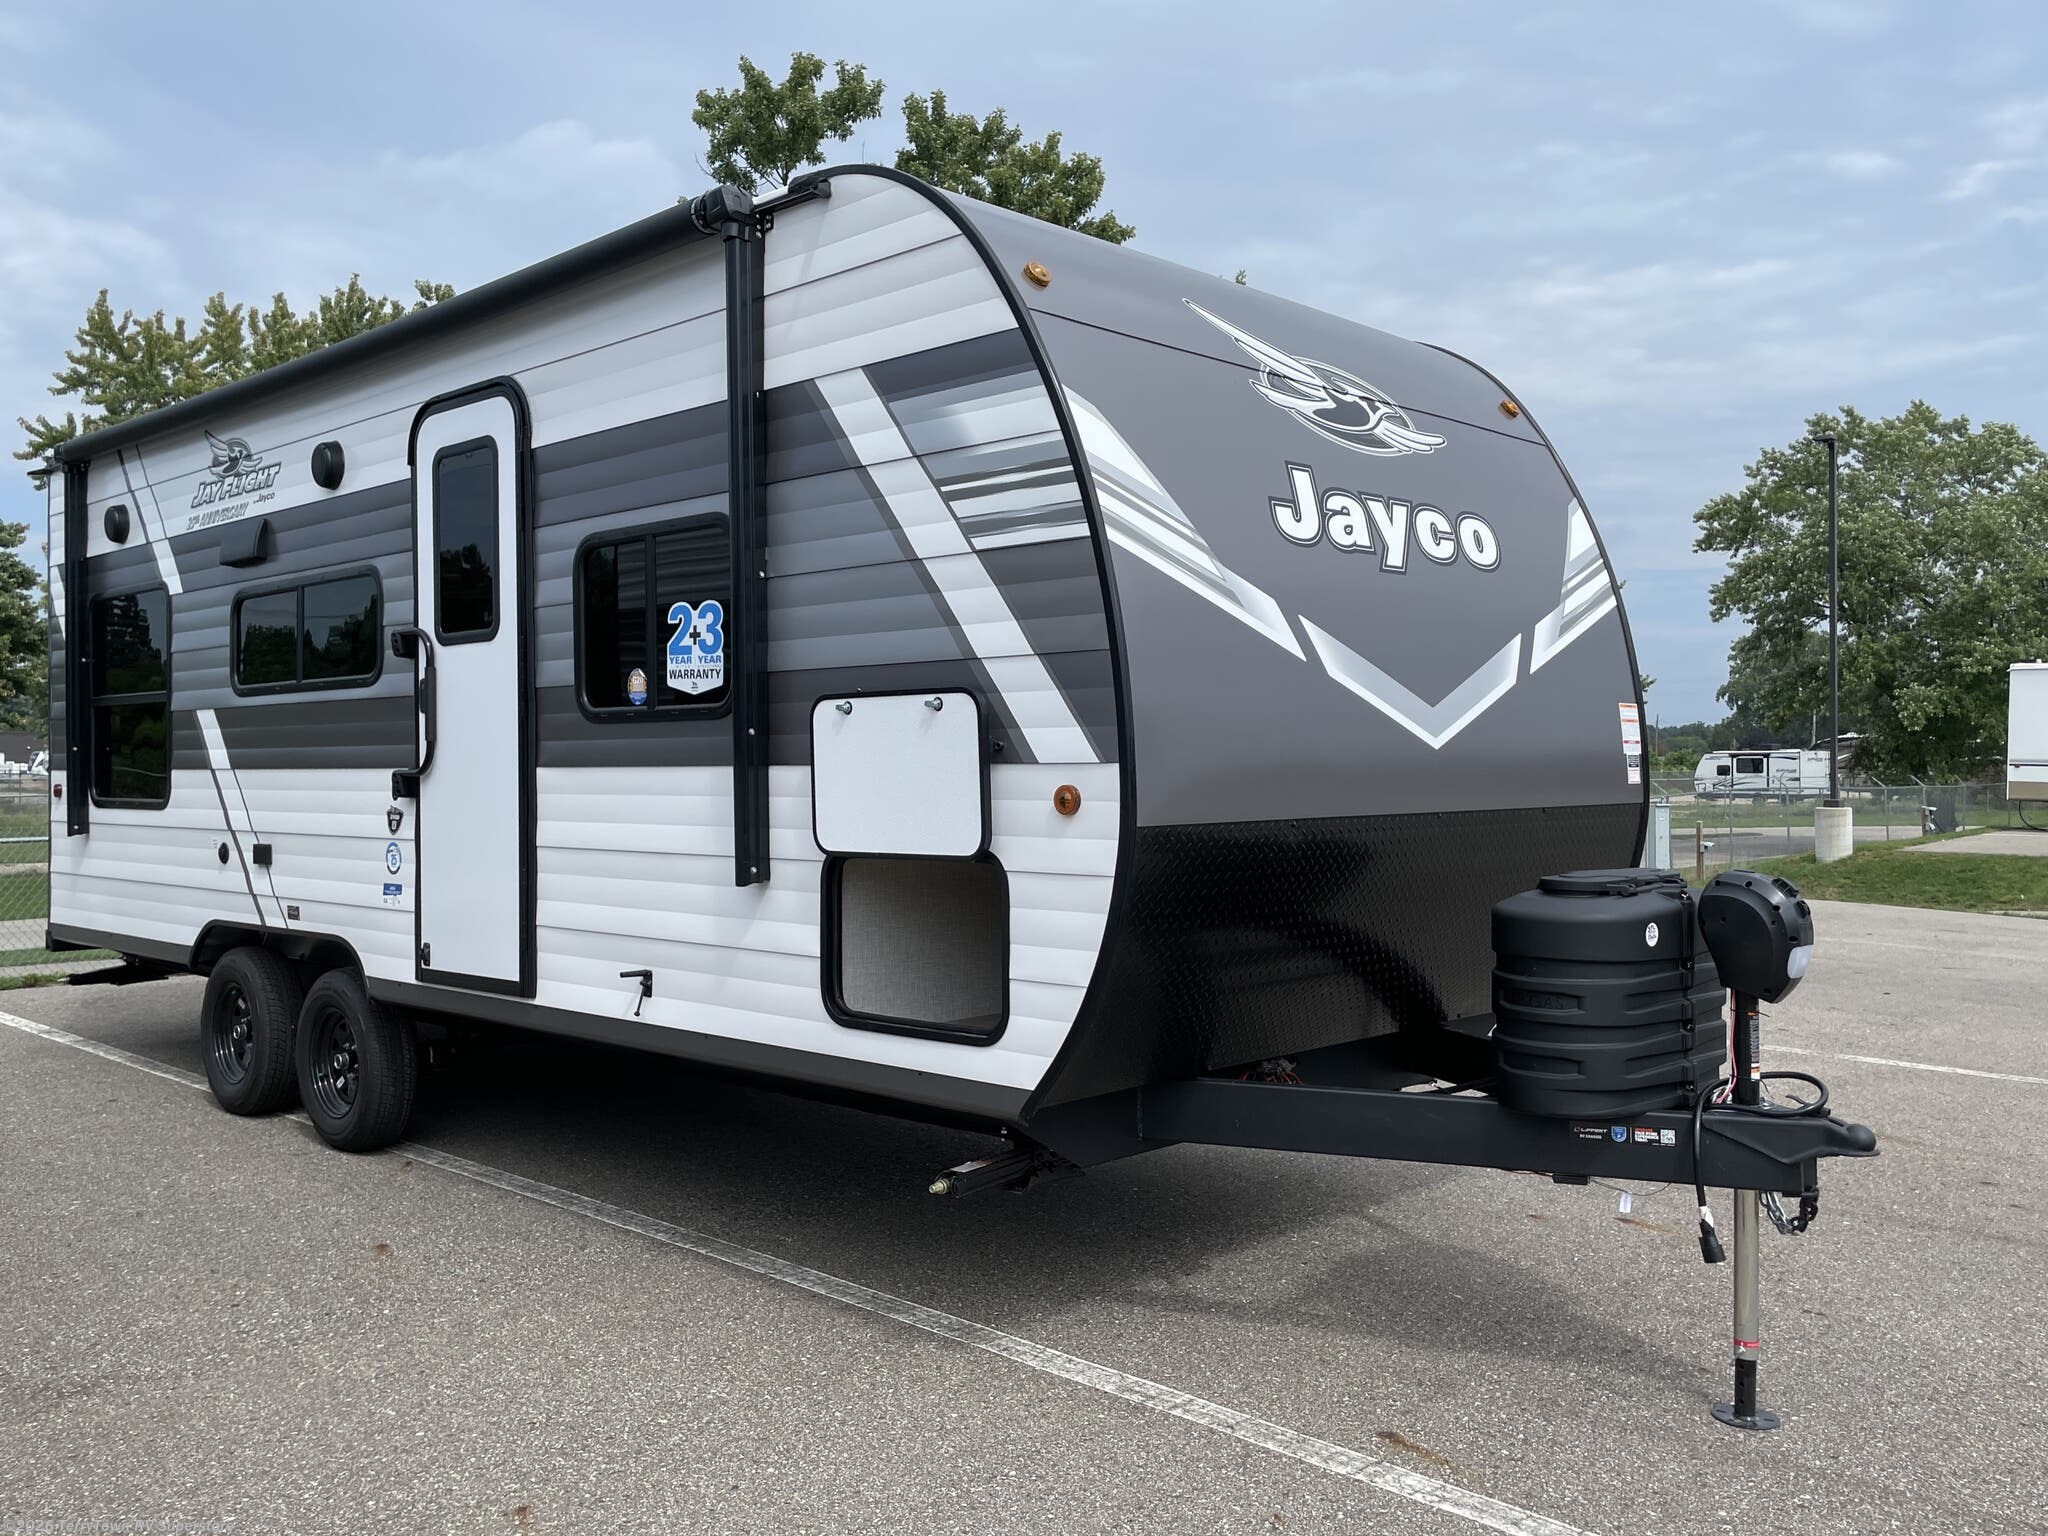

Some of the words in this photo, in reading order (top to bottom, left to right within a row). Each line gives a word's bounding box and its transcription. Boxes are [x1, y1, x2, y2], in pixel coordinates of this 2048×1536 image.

[191, 482, 221, 508] JAY
[219, 462, 282, 501] FLIGHT
[1268, 460, 1502, 575] Jayco
[669, 656, 693, 665] YEAR
[698, 655, 722, 664] YEAR
[669, 669, 722, 680] WARRANTY
